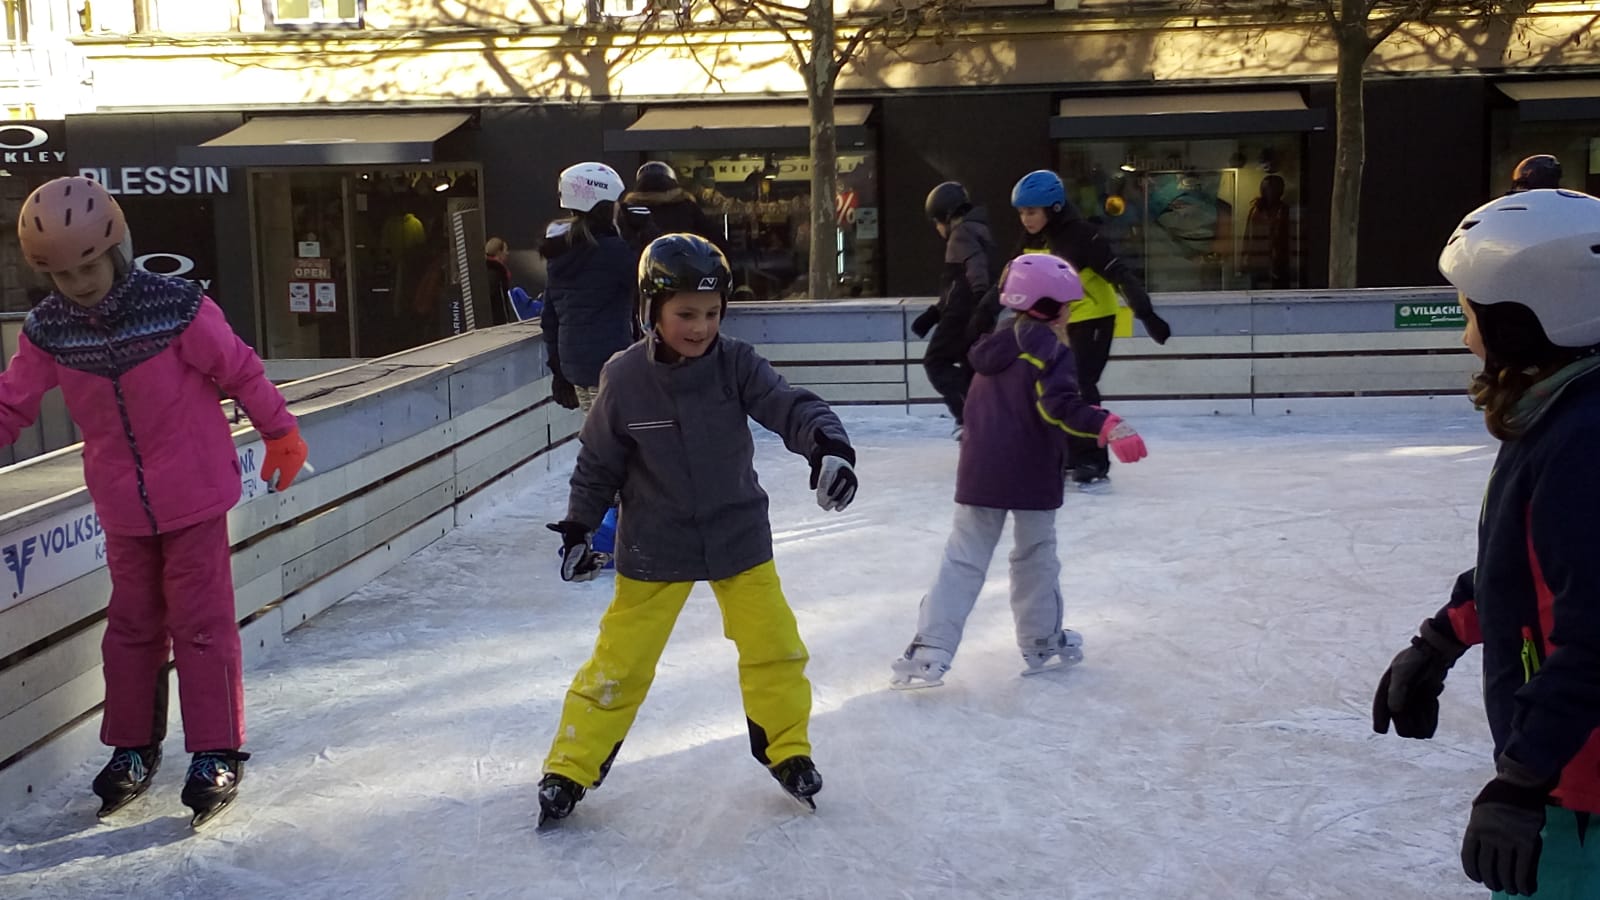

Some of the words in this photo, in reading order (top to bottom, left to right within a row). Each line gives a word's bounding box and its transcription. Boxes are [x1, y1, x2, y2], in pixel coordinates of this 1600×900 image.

[4, 151, 66, 163] KLEY
[719, 165, 760, 174] KLEY
[586, 179, 609, 190] uvex
[294, 267, 328, 278] OPEN
[1412, 305, 1465, 315] VILLACHE
[453, 301, 461, 335] ARMIN
[40, 511, 103, 558] VOLKSB
